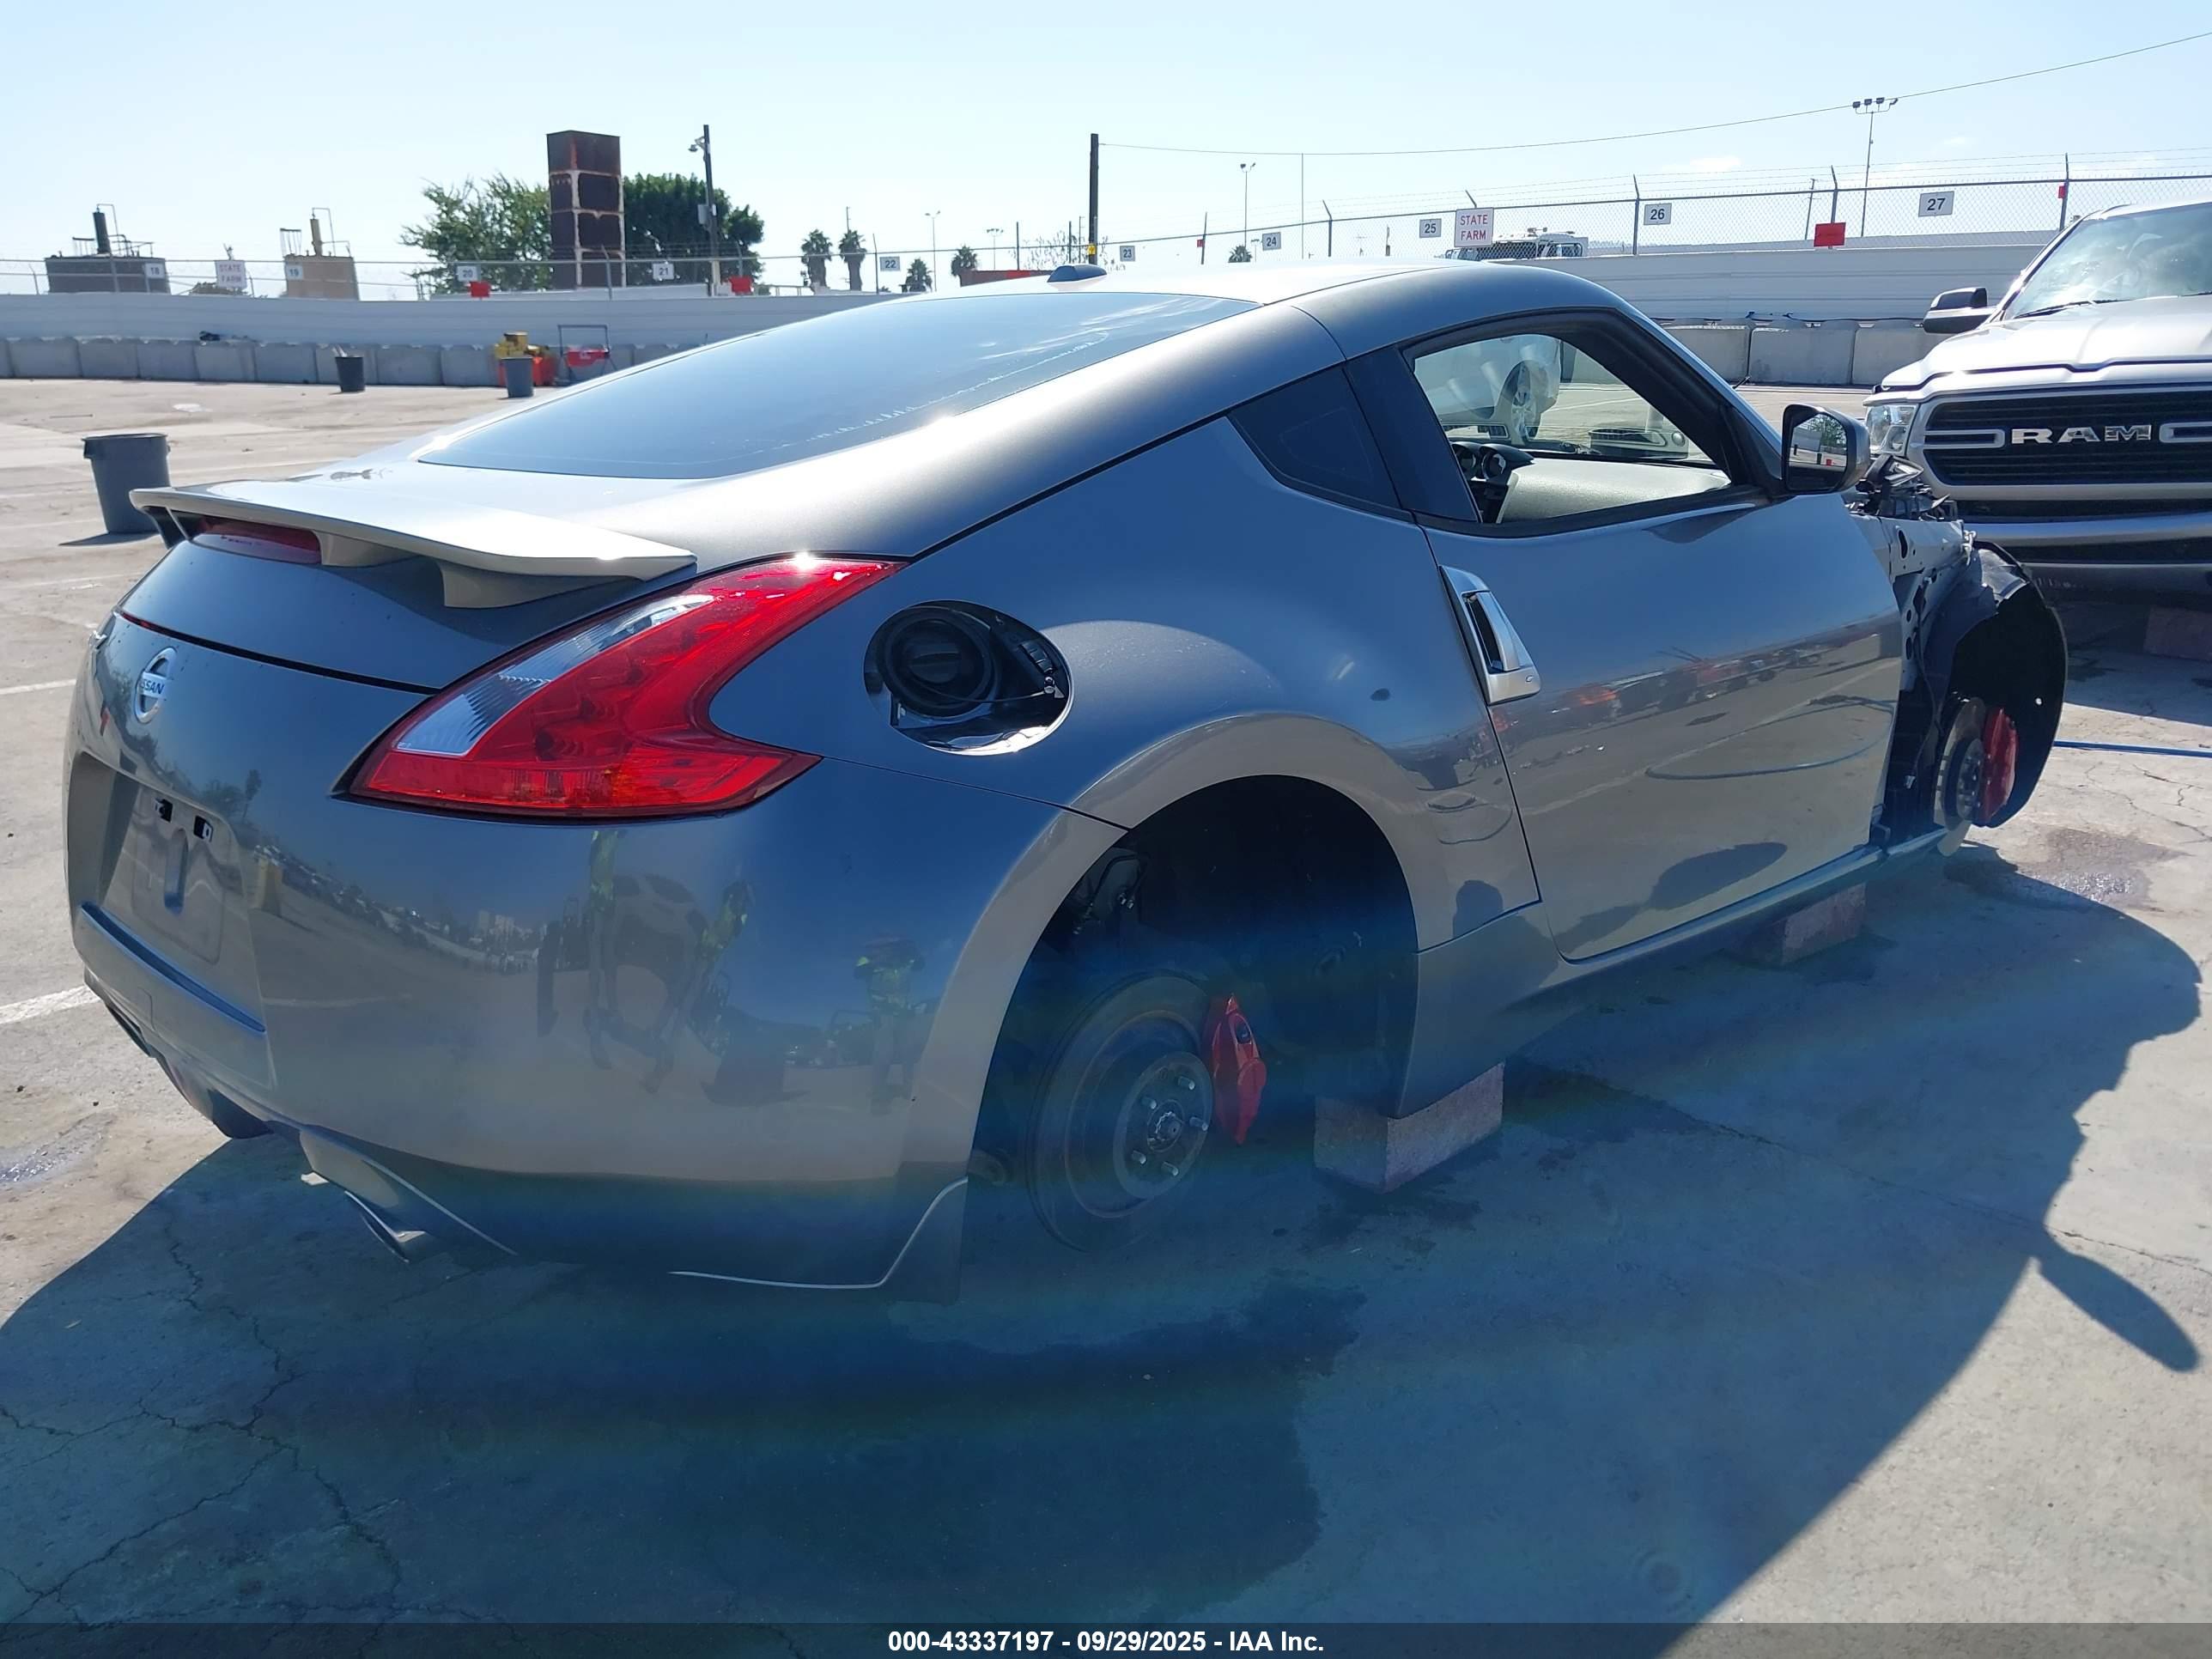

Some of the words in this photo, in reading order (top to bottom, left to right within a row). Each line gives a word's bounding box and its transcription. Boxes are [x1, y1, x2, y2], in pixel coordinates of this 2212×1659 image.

[1927, 198, 1946, 211] 27
[1460, 214, 1488, 226] STATE
[1650, 209, 1665, 221] 26
[1425, 223, 1437, 234] 25
[1461, 229, 1486, 241] FARM
[1266, 236, 1277, 247] 24
[1122, 248, 1133, 258] 23
[219, 264, 242, 272] STATE
[884, 259, 897, 269] 22
[2011, 424, 2152, 445] RAM
[139, 678, 165, 694] SSAN
